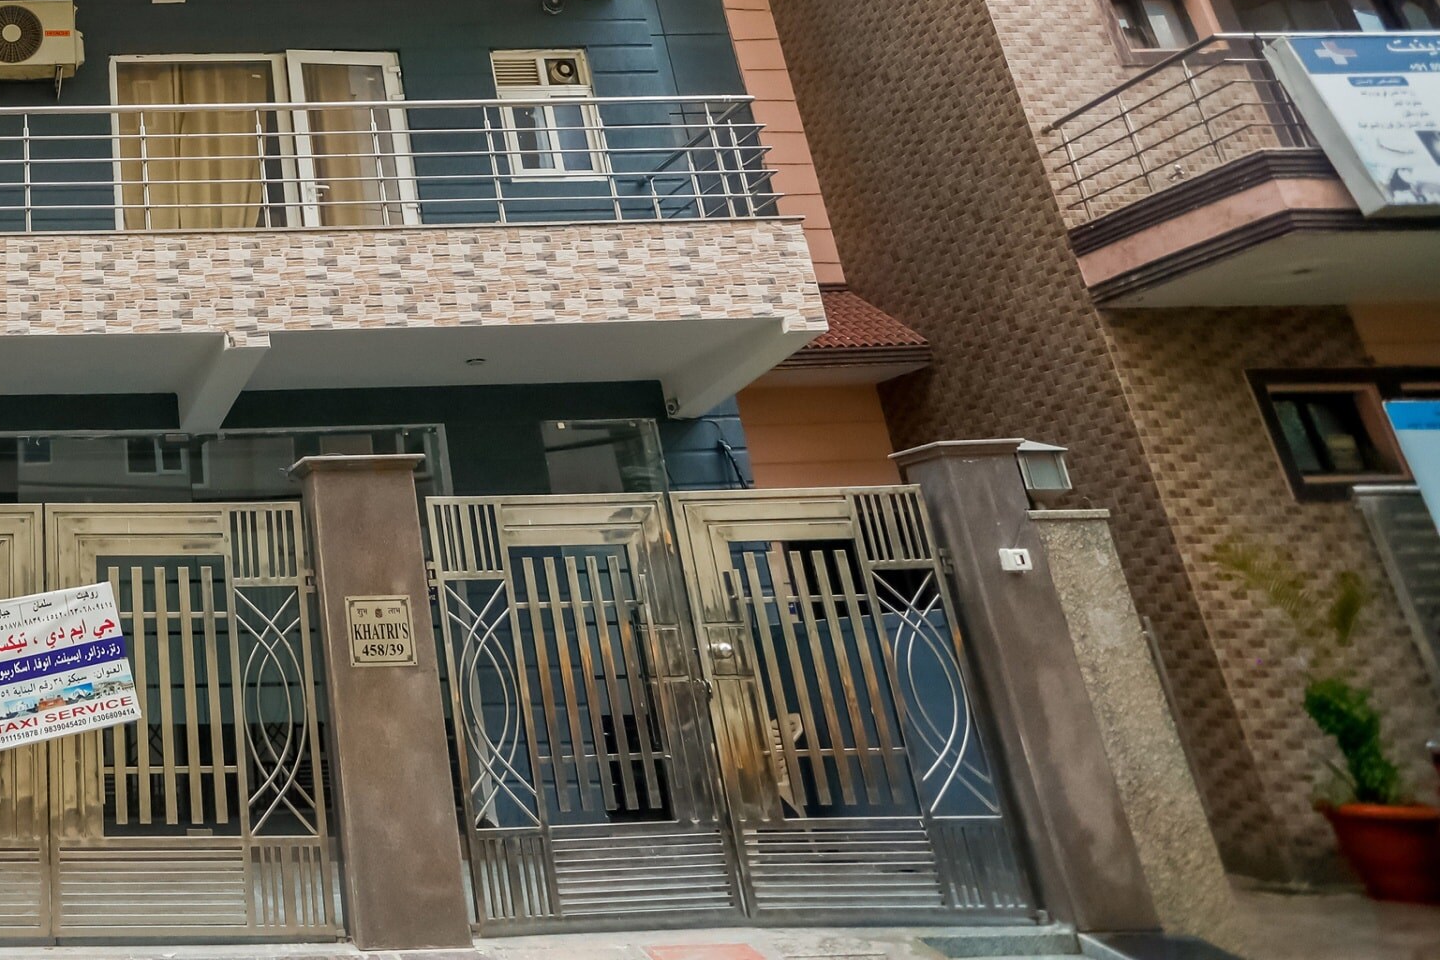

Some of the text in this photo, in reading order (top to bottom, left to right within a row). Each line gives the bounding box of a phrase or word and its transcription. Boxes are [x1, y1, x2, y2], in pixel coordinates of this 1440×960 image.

[357, 607, 401, 617] शुभ लाभ
[353, 622, 409, 640] KHATRI'S
[362, 643, 404, 656] 458/39
[45, 696, 133, 723] SERVICE
[44, 718, 87, 734] 9839045420
[93, 708, 136, 723] 6306809414
